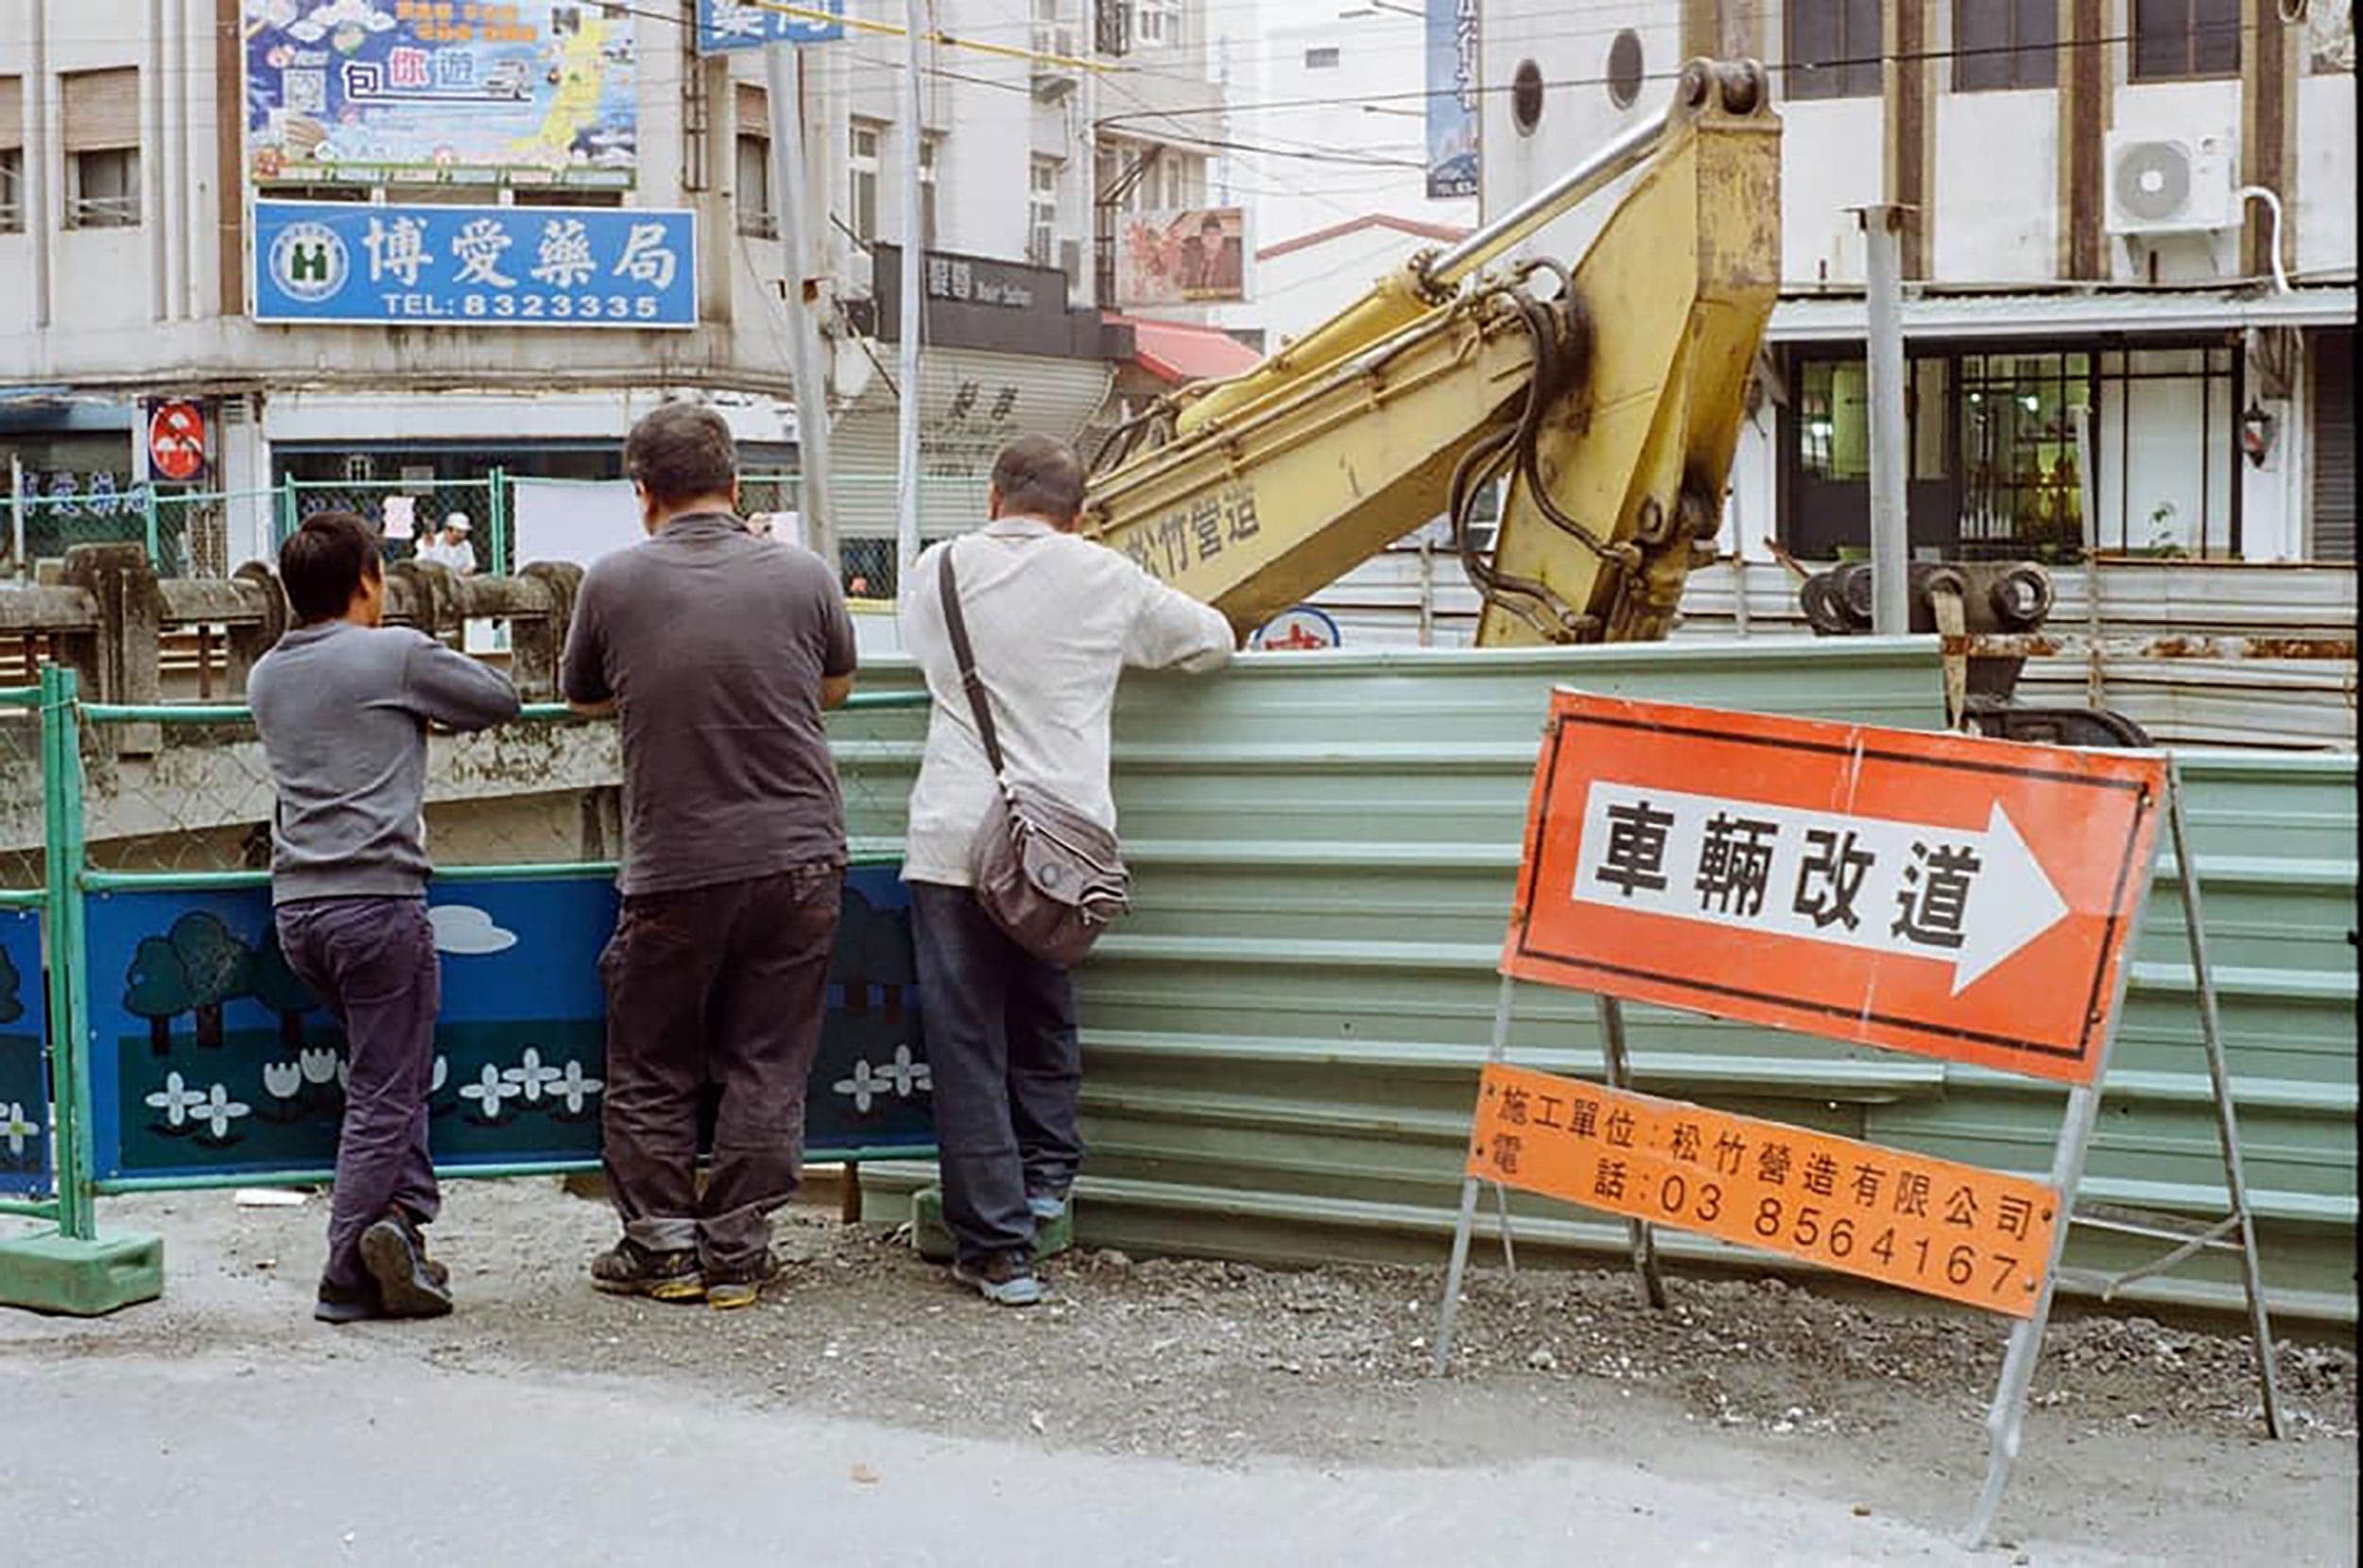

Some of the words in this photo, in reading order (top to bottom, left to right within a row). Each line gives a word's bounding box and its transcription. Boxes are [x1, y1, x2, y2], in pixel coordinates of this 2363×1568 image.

[363, 215, 676, 289] 博愛藥局
[1125, 483, 1261, 577] 松竹營造
[1595, 801, 1982, 949] 車輛改道
[1755, 1197, 2018, 1293] 8564167
